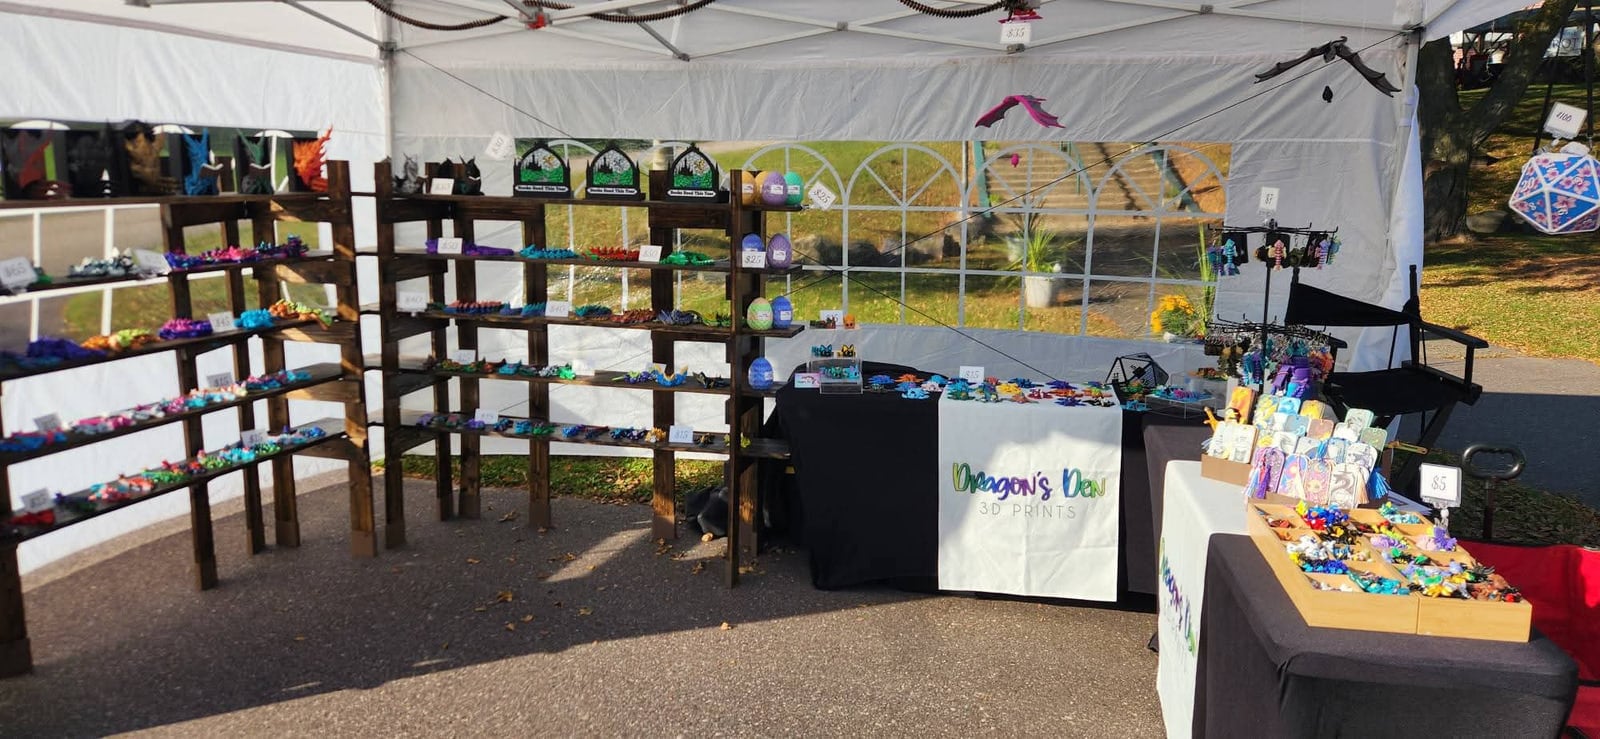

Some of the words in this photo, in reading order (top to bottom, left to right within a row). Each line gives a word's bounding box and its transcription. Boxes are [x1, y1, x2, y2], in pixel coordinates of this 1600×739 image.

[814, 189, 831, 204] $25
[744, 255, 762, 264] $25
[952, 462, 1053, 501] Dragon's
[1062, 468, 1106, 498] Den
[1432, 475, 1447, 491] $5
[979, 502, 1001, 516] 3D
[1012, 503, 1076, 519] PRINTS
